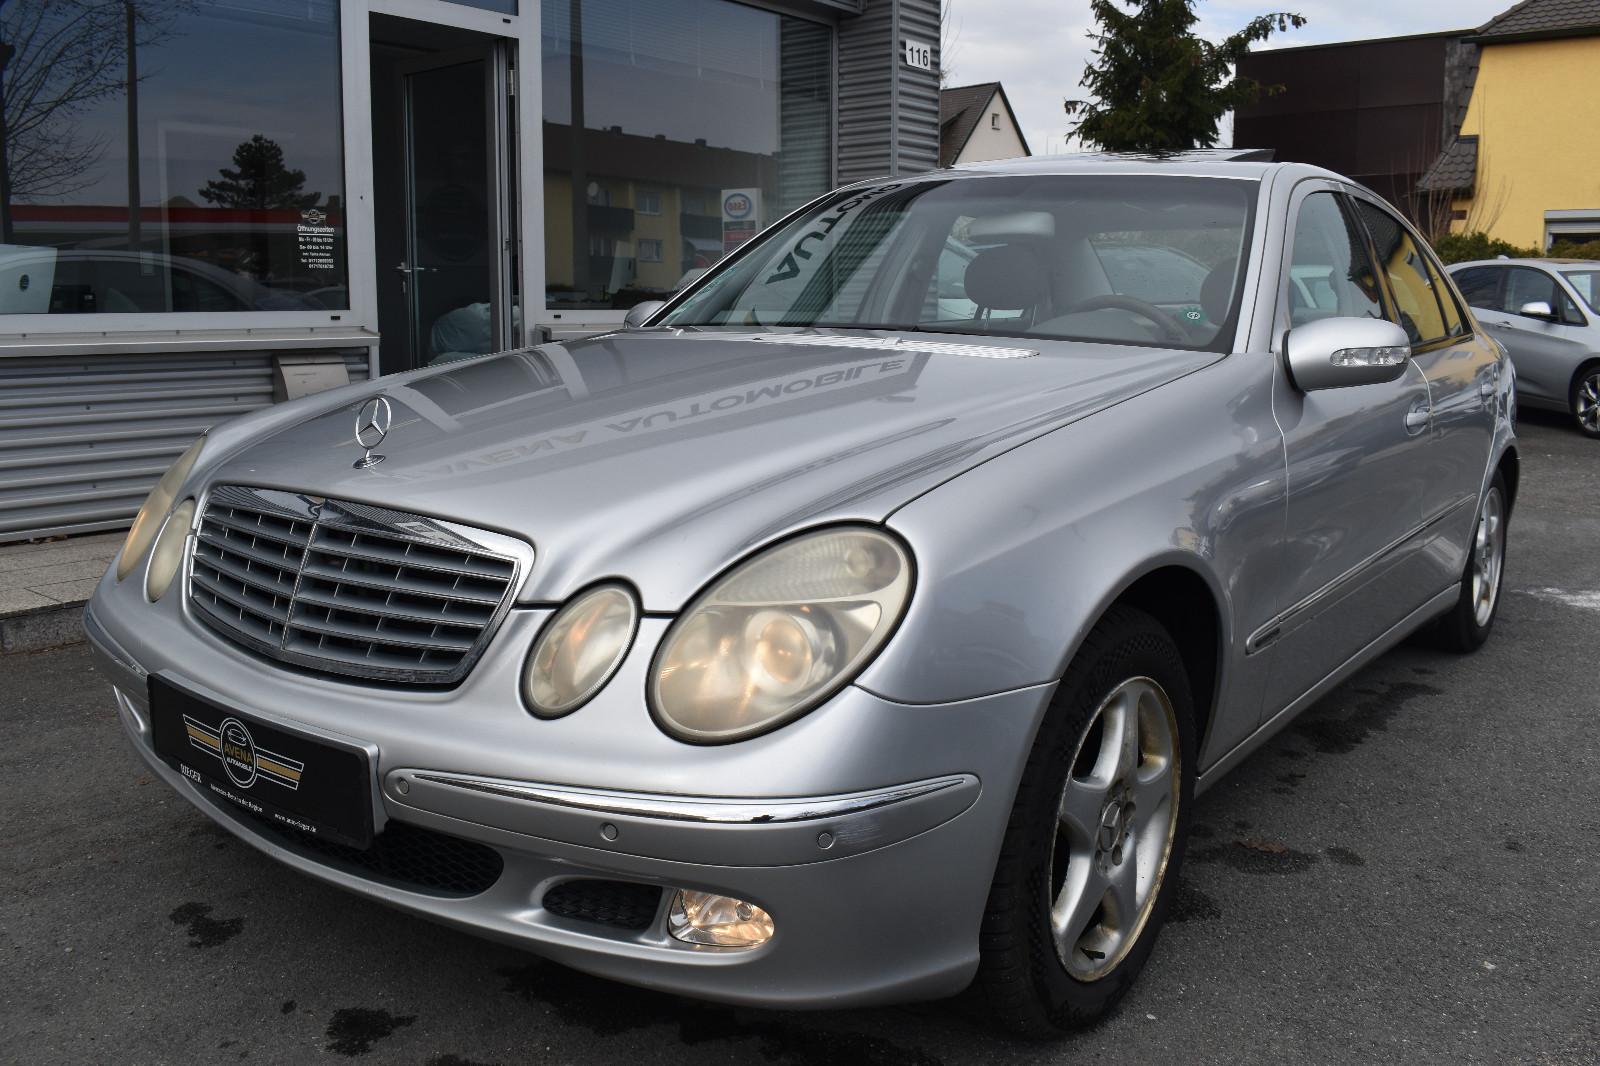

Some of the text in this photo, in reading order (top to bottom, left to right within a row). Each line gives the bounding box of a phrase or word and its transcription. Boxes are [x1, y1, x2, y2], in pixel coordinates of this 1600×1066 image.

[909, 46, 928, 67] 116
[297, 224, 334, 233] Öffnungszeiten
[224, 742, 253, 764] AVENA
